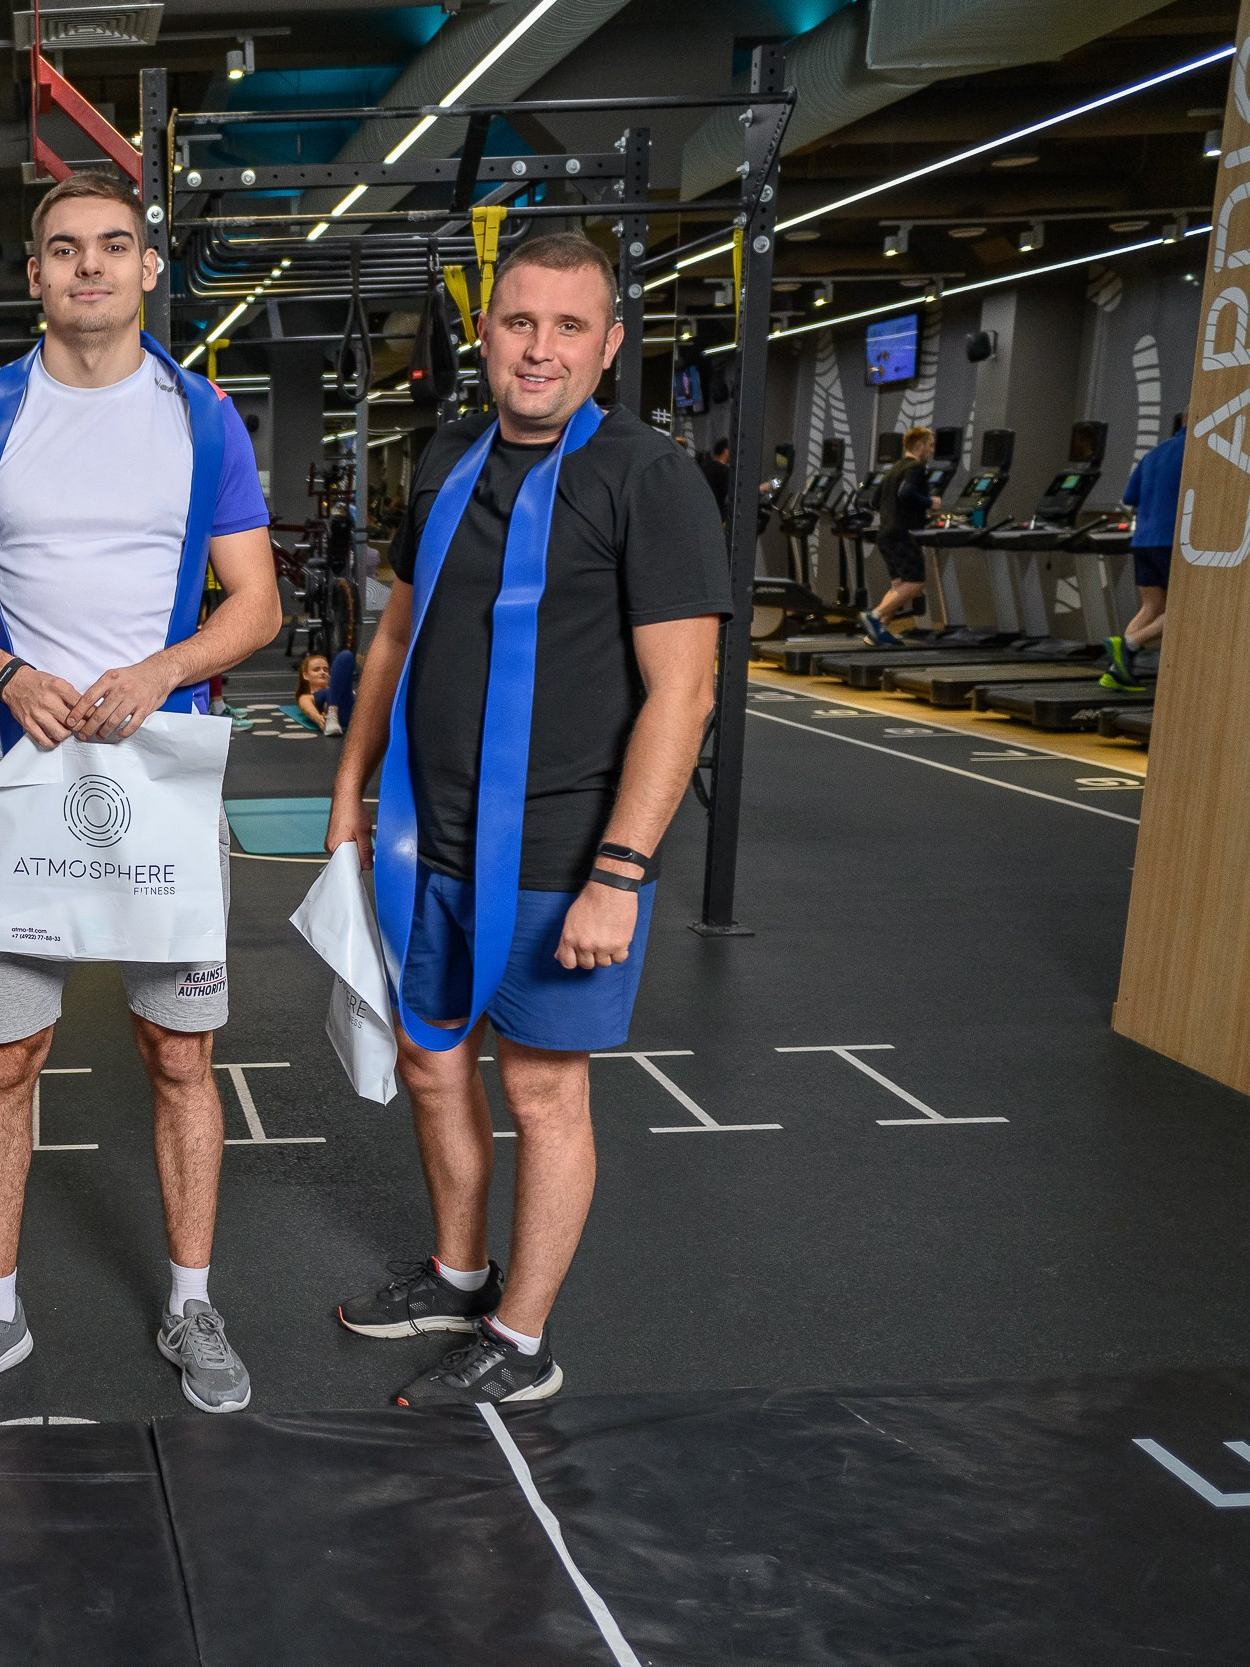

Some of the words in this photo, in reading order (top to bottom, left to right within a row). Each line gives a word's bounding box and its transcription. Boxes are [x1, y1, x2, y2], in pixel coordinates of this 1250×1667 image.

[1180, 36, 1250, 567] CARD
[13, 856, 175, 884] ATMOSPHERE
[134, 886, 176, 896] FITNESS
[11, 926, 47, 934] atmo-fit.com
[184, 966, 224, 983] AGAINST
[178, 979, 226, 997] AUTHORITY
